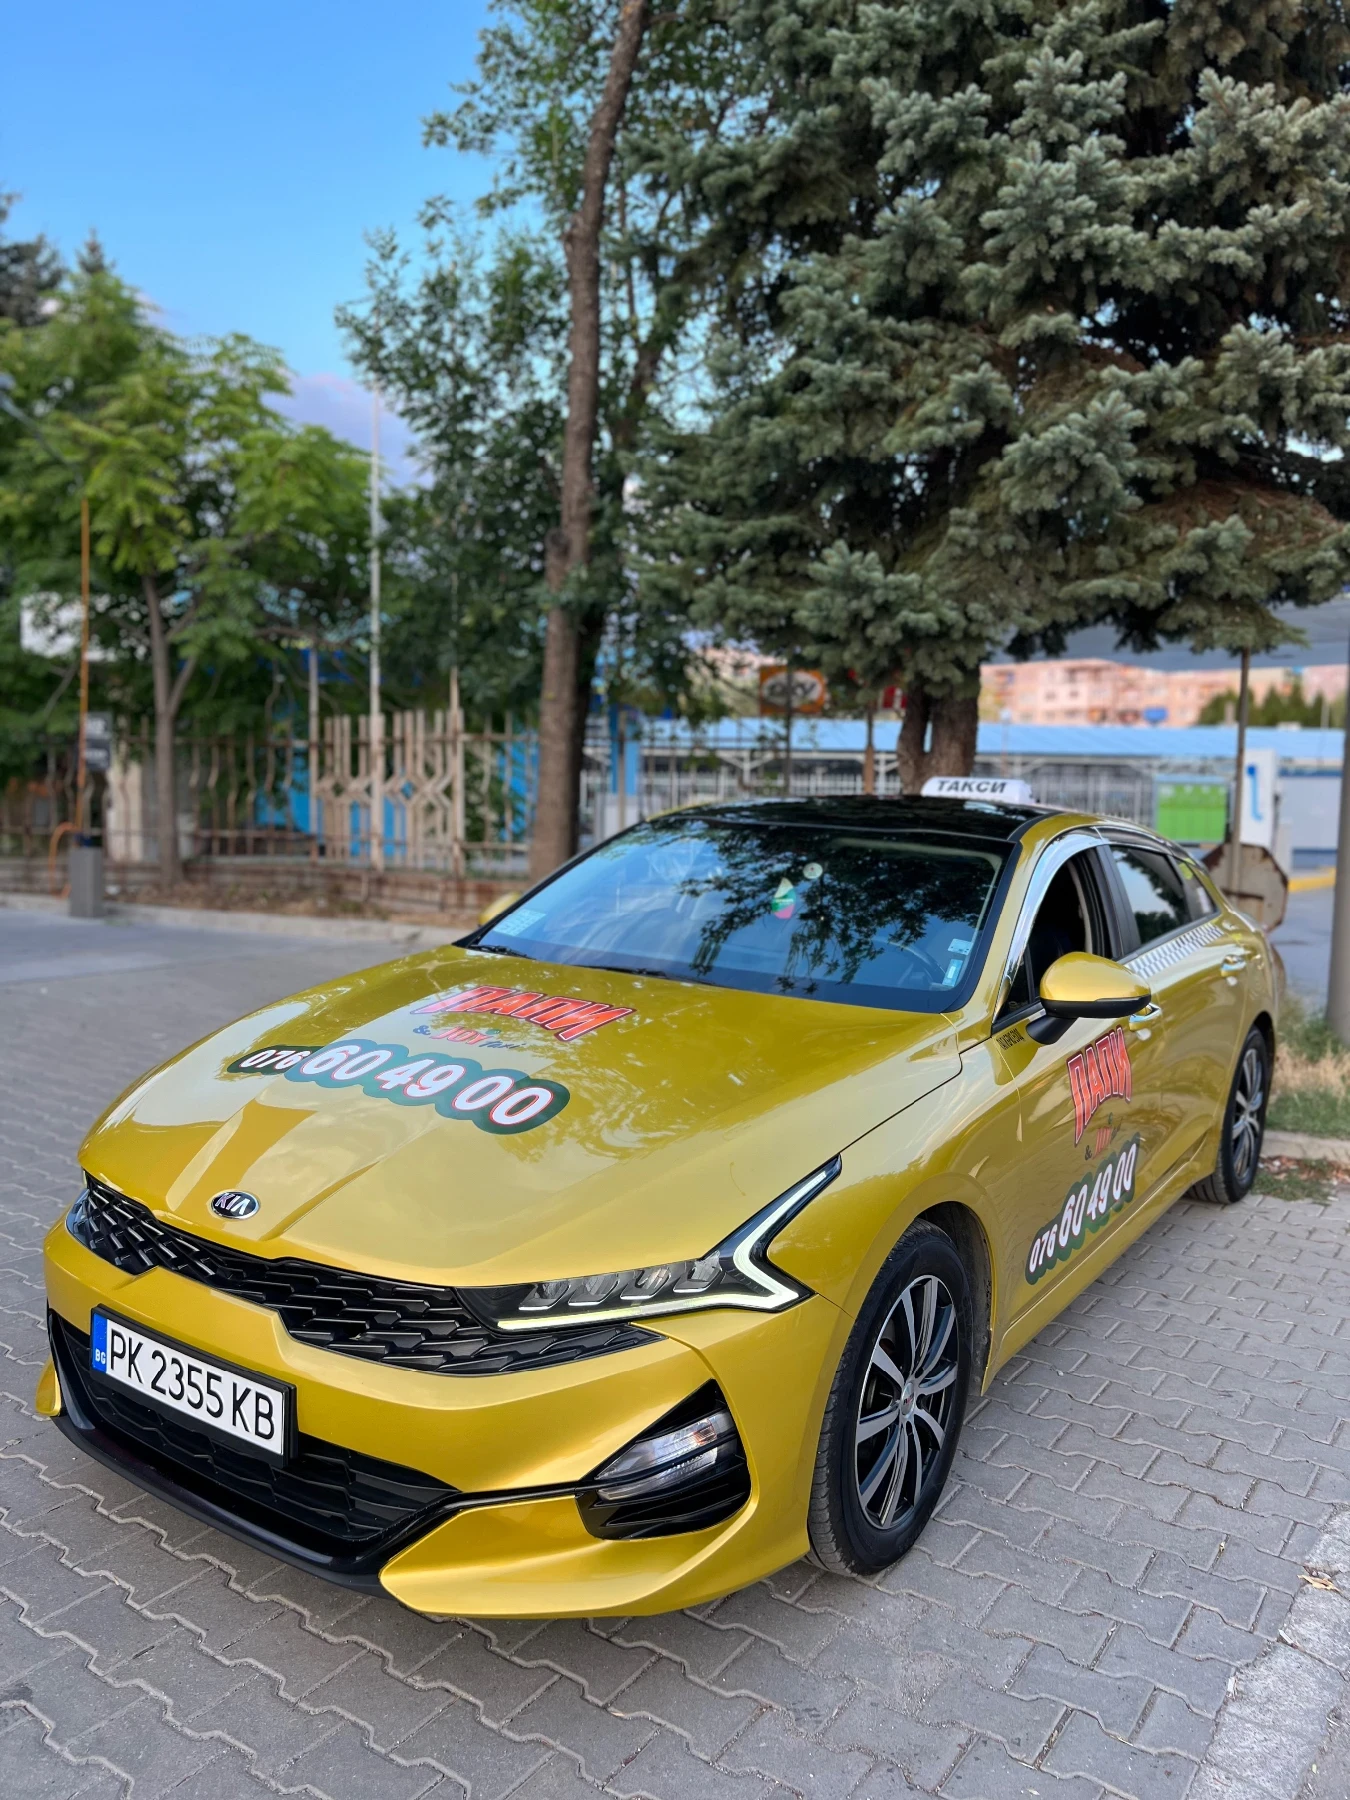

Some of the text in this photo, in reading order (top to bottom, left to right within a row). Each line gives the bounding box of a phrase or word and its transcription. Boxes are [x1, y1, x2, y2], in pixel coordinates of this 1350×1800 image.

[937, 780, 1007, 793] ТАКСИ
[411, 985, 635, 1041] ПАПИ
[413, 1025, 431, 1036] &
[239, 1039, 554, 1126] 076 60 49 00
[1067, 1026, 1132, 1146] ПАПИ
[214, 1192, 251, 1215] KIA
[1028, 1142, 1137, 1274] 076 60 49 00
[94, 1348, 106, 1365] BG
[110, 1328, 275, 1441] PK 2355 KB
